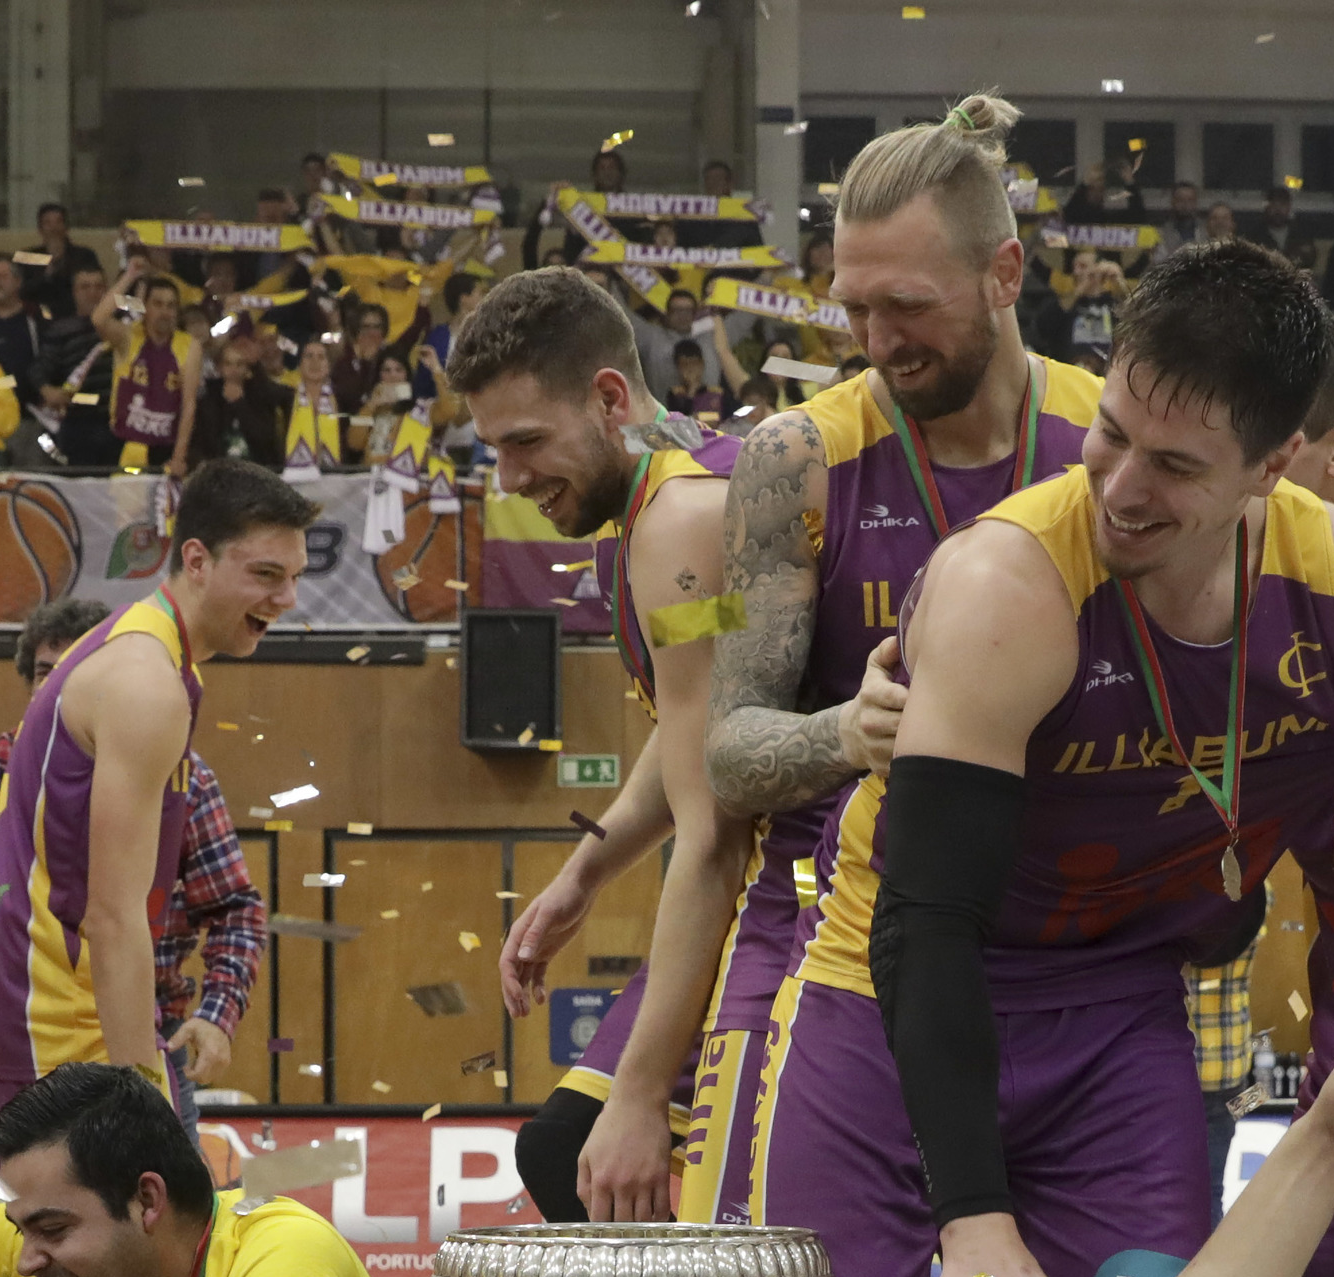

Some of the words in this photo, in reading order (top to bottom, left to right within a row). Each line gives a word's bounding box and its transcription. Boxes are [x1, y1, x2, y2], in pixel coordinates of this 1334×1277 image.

[359, 200, 474, 227] ILLIABUM
[166, 222, 280, 248] ILLIABUM
[860, 517, 920, 529] DHIKA
[1085, 671, 1135, 693] DHIKA
